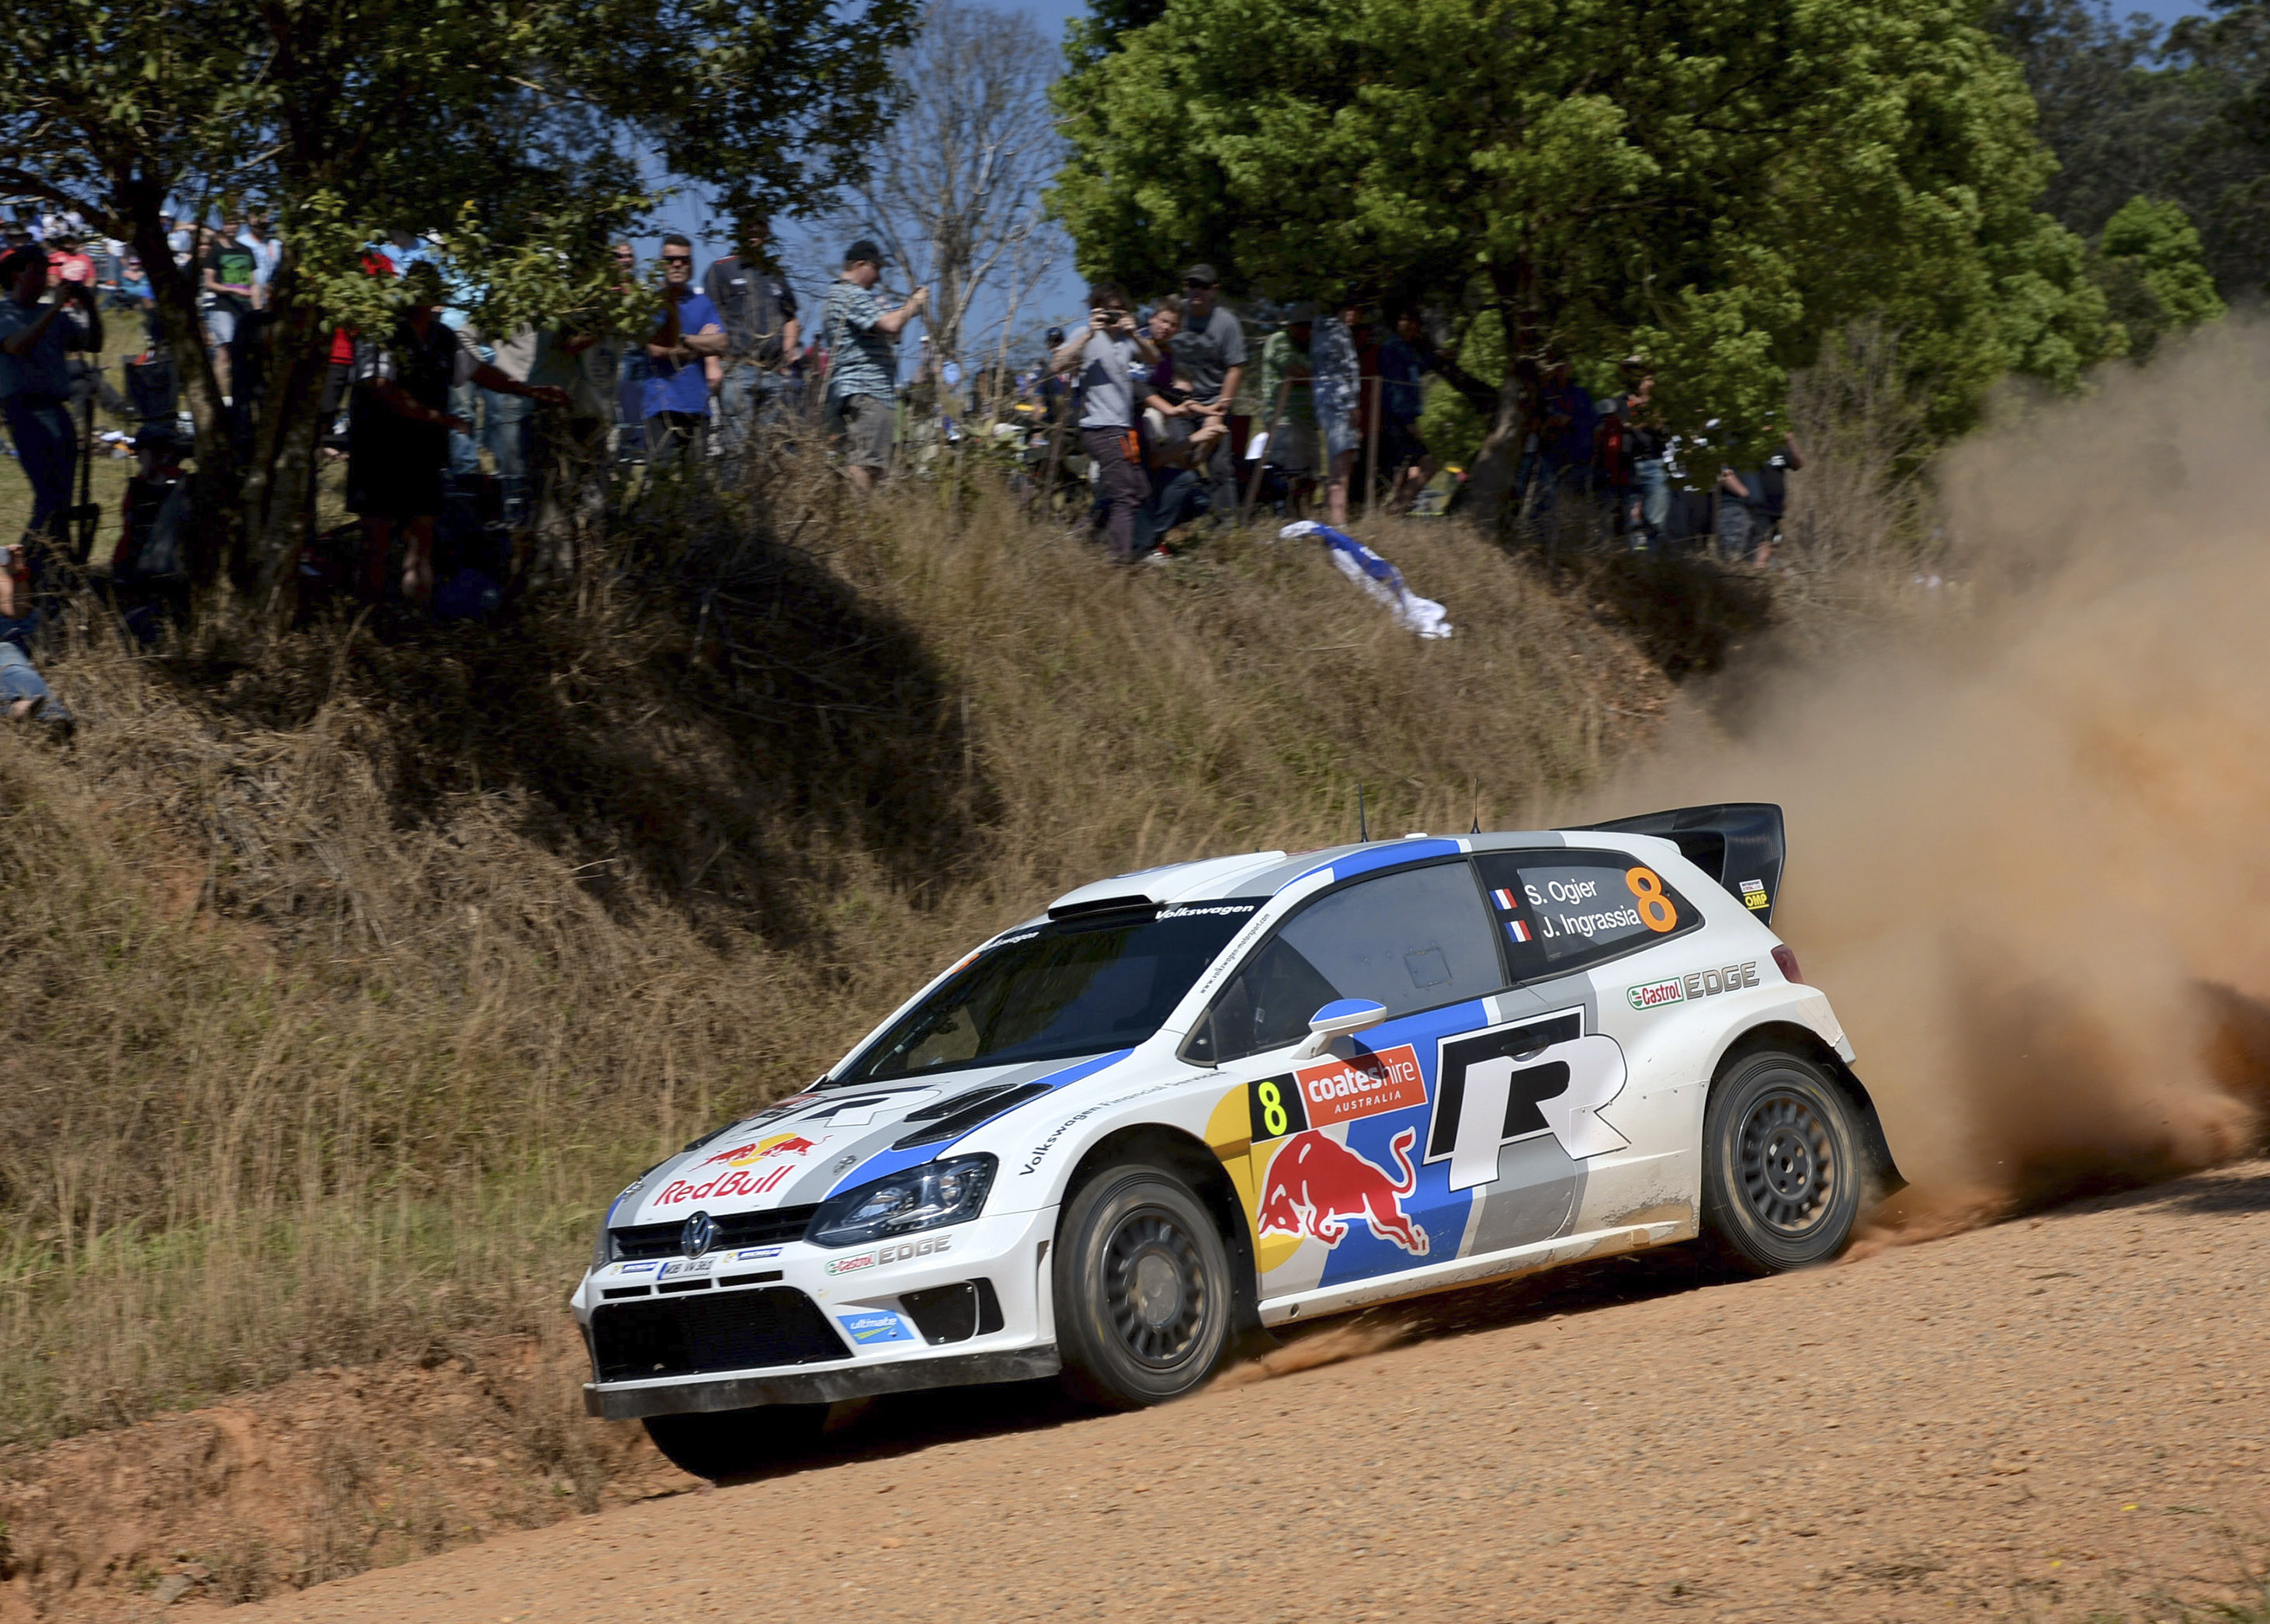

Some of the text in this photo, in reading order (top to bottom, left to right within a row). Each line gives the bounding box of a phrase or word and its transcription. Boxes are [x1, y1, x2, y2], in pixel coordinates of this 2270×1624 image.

[1525, 878, 1598, 905] S. Ogier
[1626, 866, 1678, 933] 8
[1745, 894, 1767, 907] OMP
[1155, 905, 1255, 919] Volkswagen
[1543, 905, 1641, 939] J. Ingrassia
[1642, 961, 1760, 1005] Castrol EDGE
[1258, 1081, 1287, 1136] 8
[1335, 1090, 1402, 1114] AUSTRALIA
[1019, 1106, 1102, 1176] Volkswagen
[1099, 1085, 1166, 1108] Financial
[879, 1234, 953, 1265] EDGE
[850, 1317, 897, 1330] ultimate
